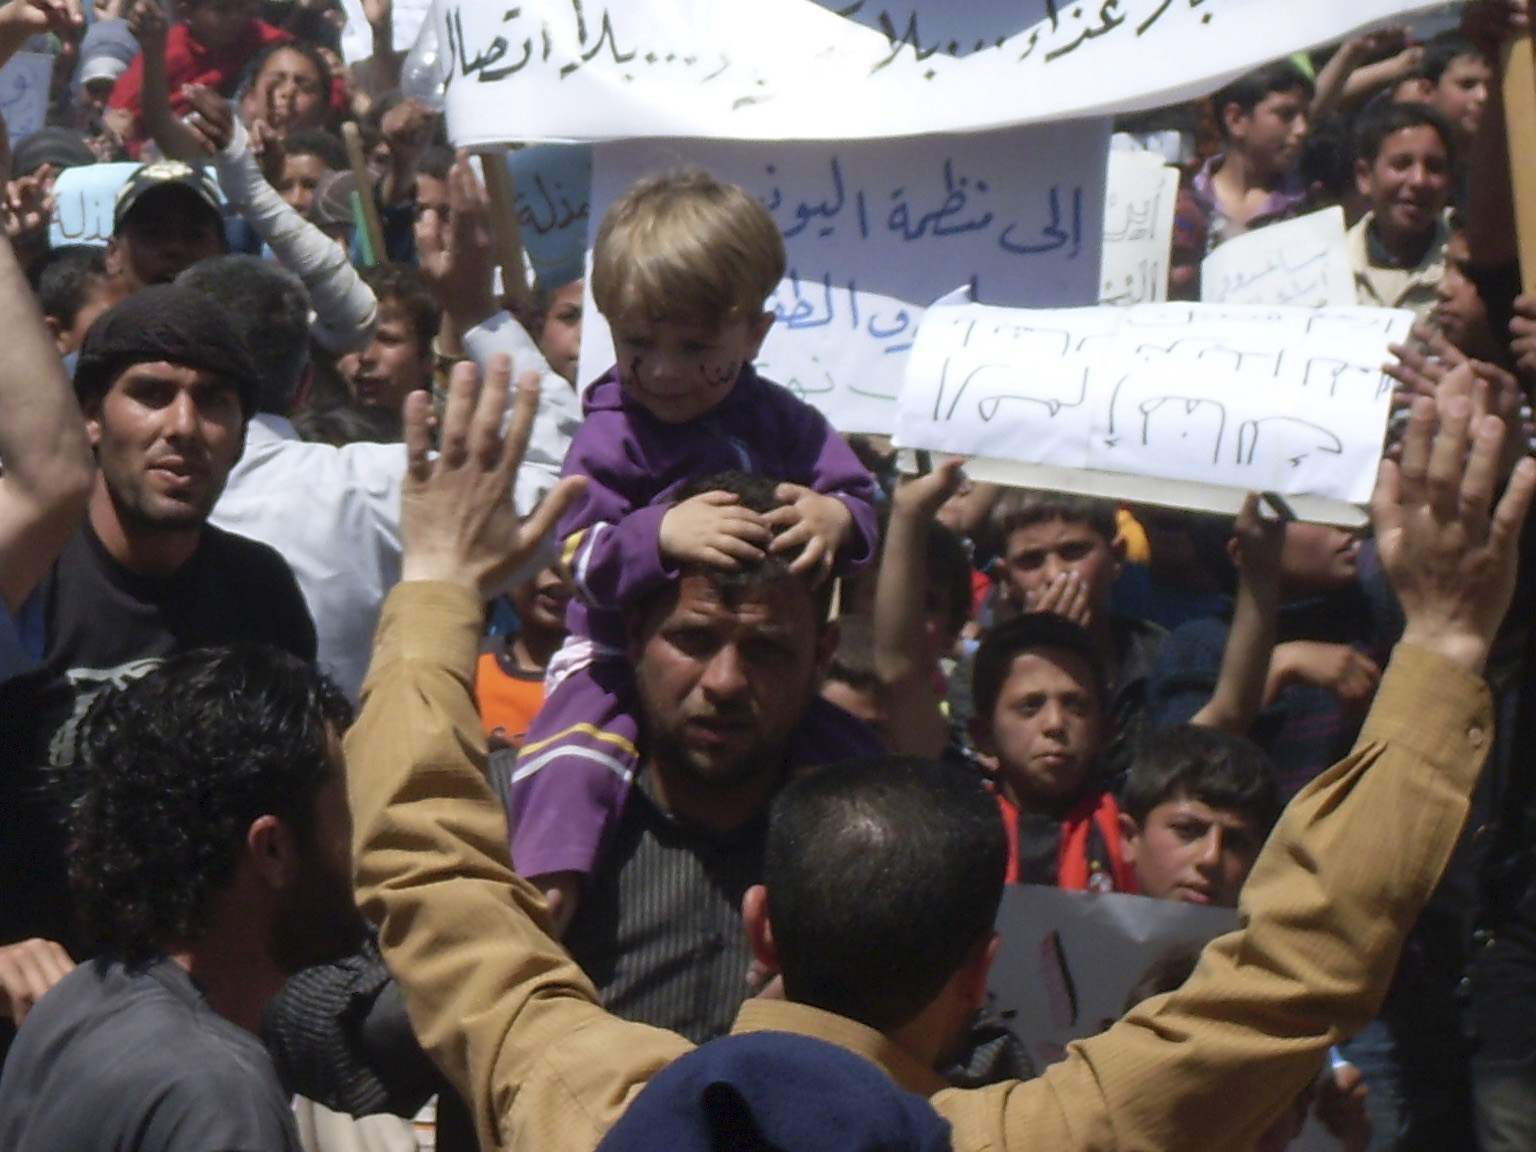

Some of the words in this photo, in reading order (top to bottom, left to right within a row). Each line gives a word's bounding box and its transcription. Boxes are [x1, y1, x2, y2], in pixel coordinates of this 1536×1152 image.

[866, 9, 941, 81] بلا
[885, 157, 995, 239] منظمة
[770, 268, 859, 330] الطف
